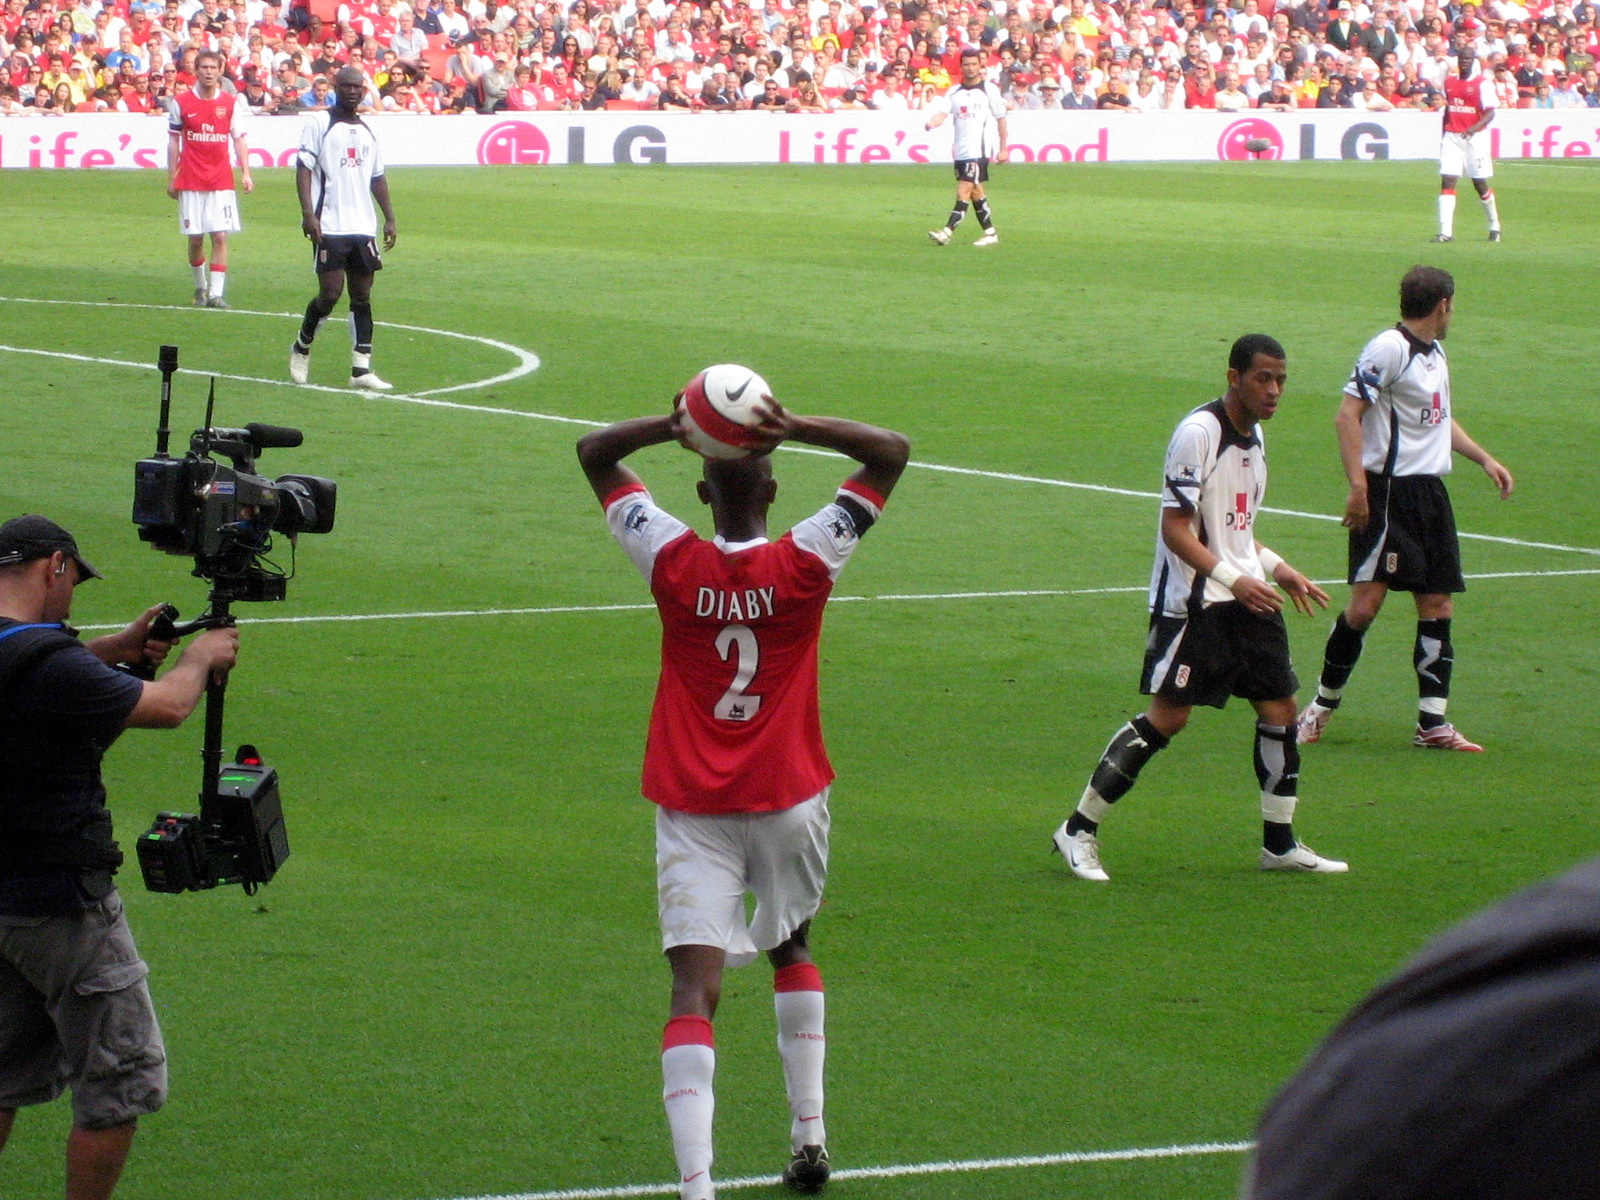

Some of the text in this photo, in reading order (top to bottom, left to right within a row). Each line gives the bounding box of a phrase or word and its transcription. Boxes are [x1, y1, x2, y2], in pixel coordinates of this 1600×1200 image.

[951, 127, 1109, 163] ood
[696, 585, 776, 620] DIABY
[713, 623, 762, 722] 2
